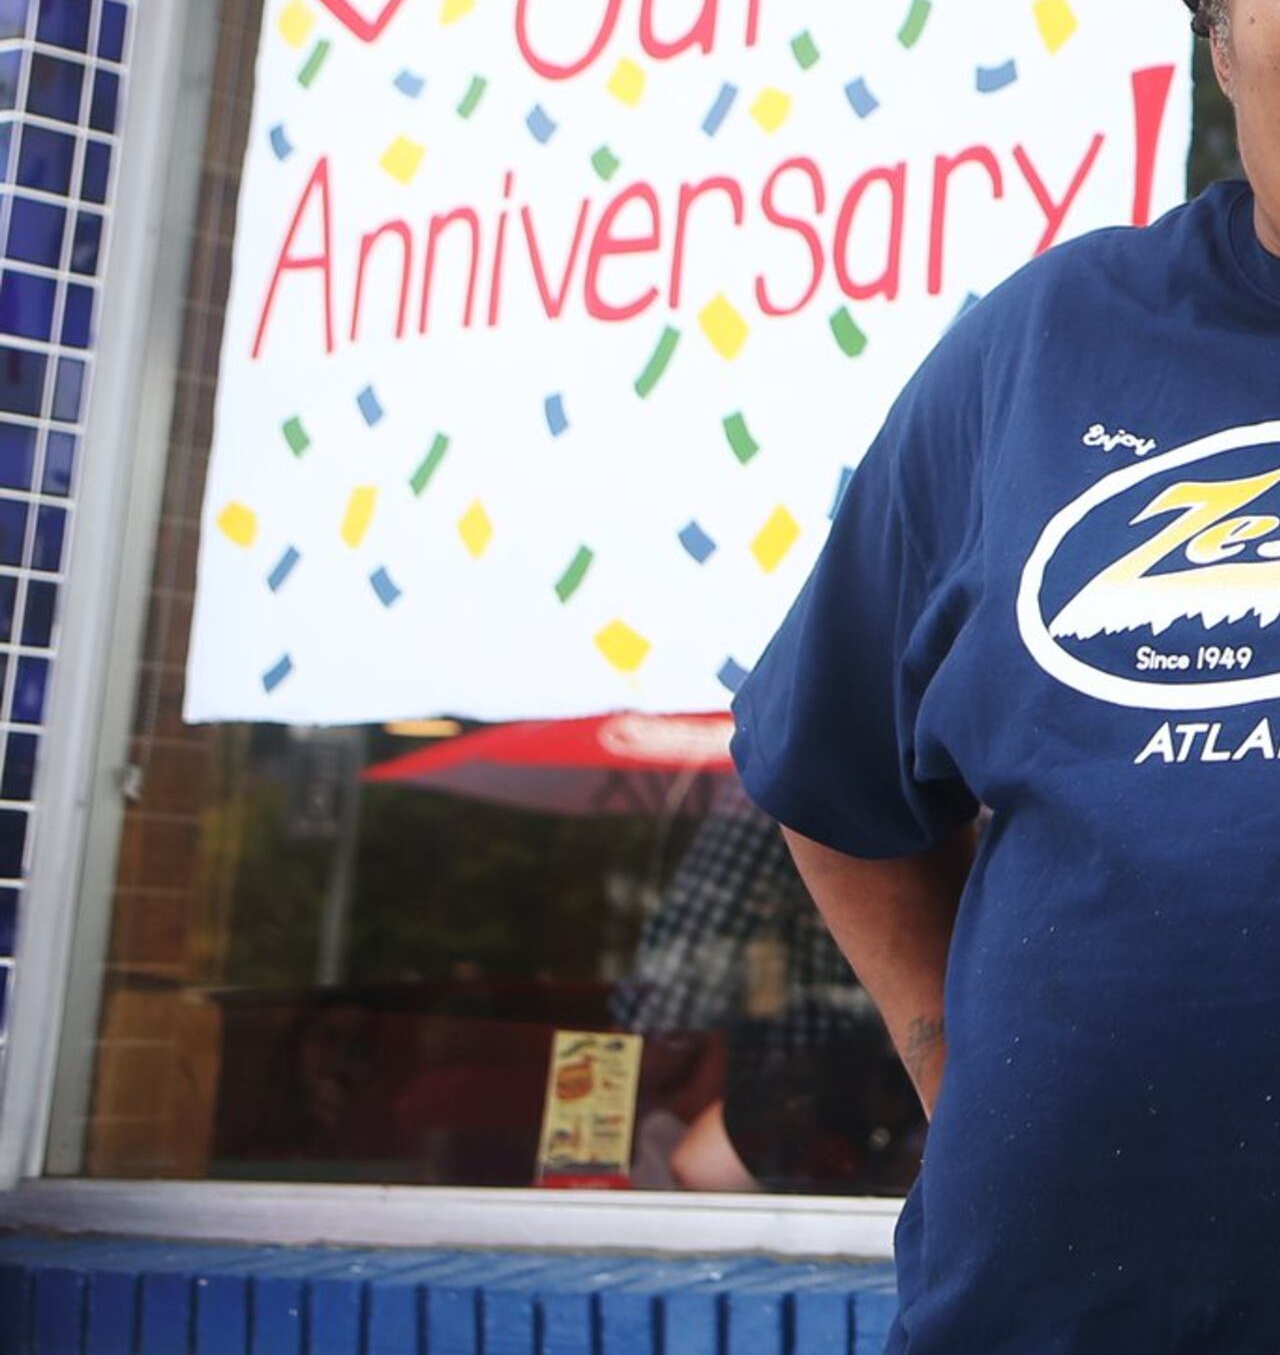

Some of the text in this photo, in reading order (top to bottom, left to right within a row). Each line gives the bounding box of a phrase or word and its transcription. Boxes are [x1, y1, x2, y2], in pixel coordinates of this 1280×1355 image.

[1083, 423, 1157, 456] Enjoy
[1136, 646, 1253, 670] Since 1949
